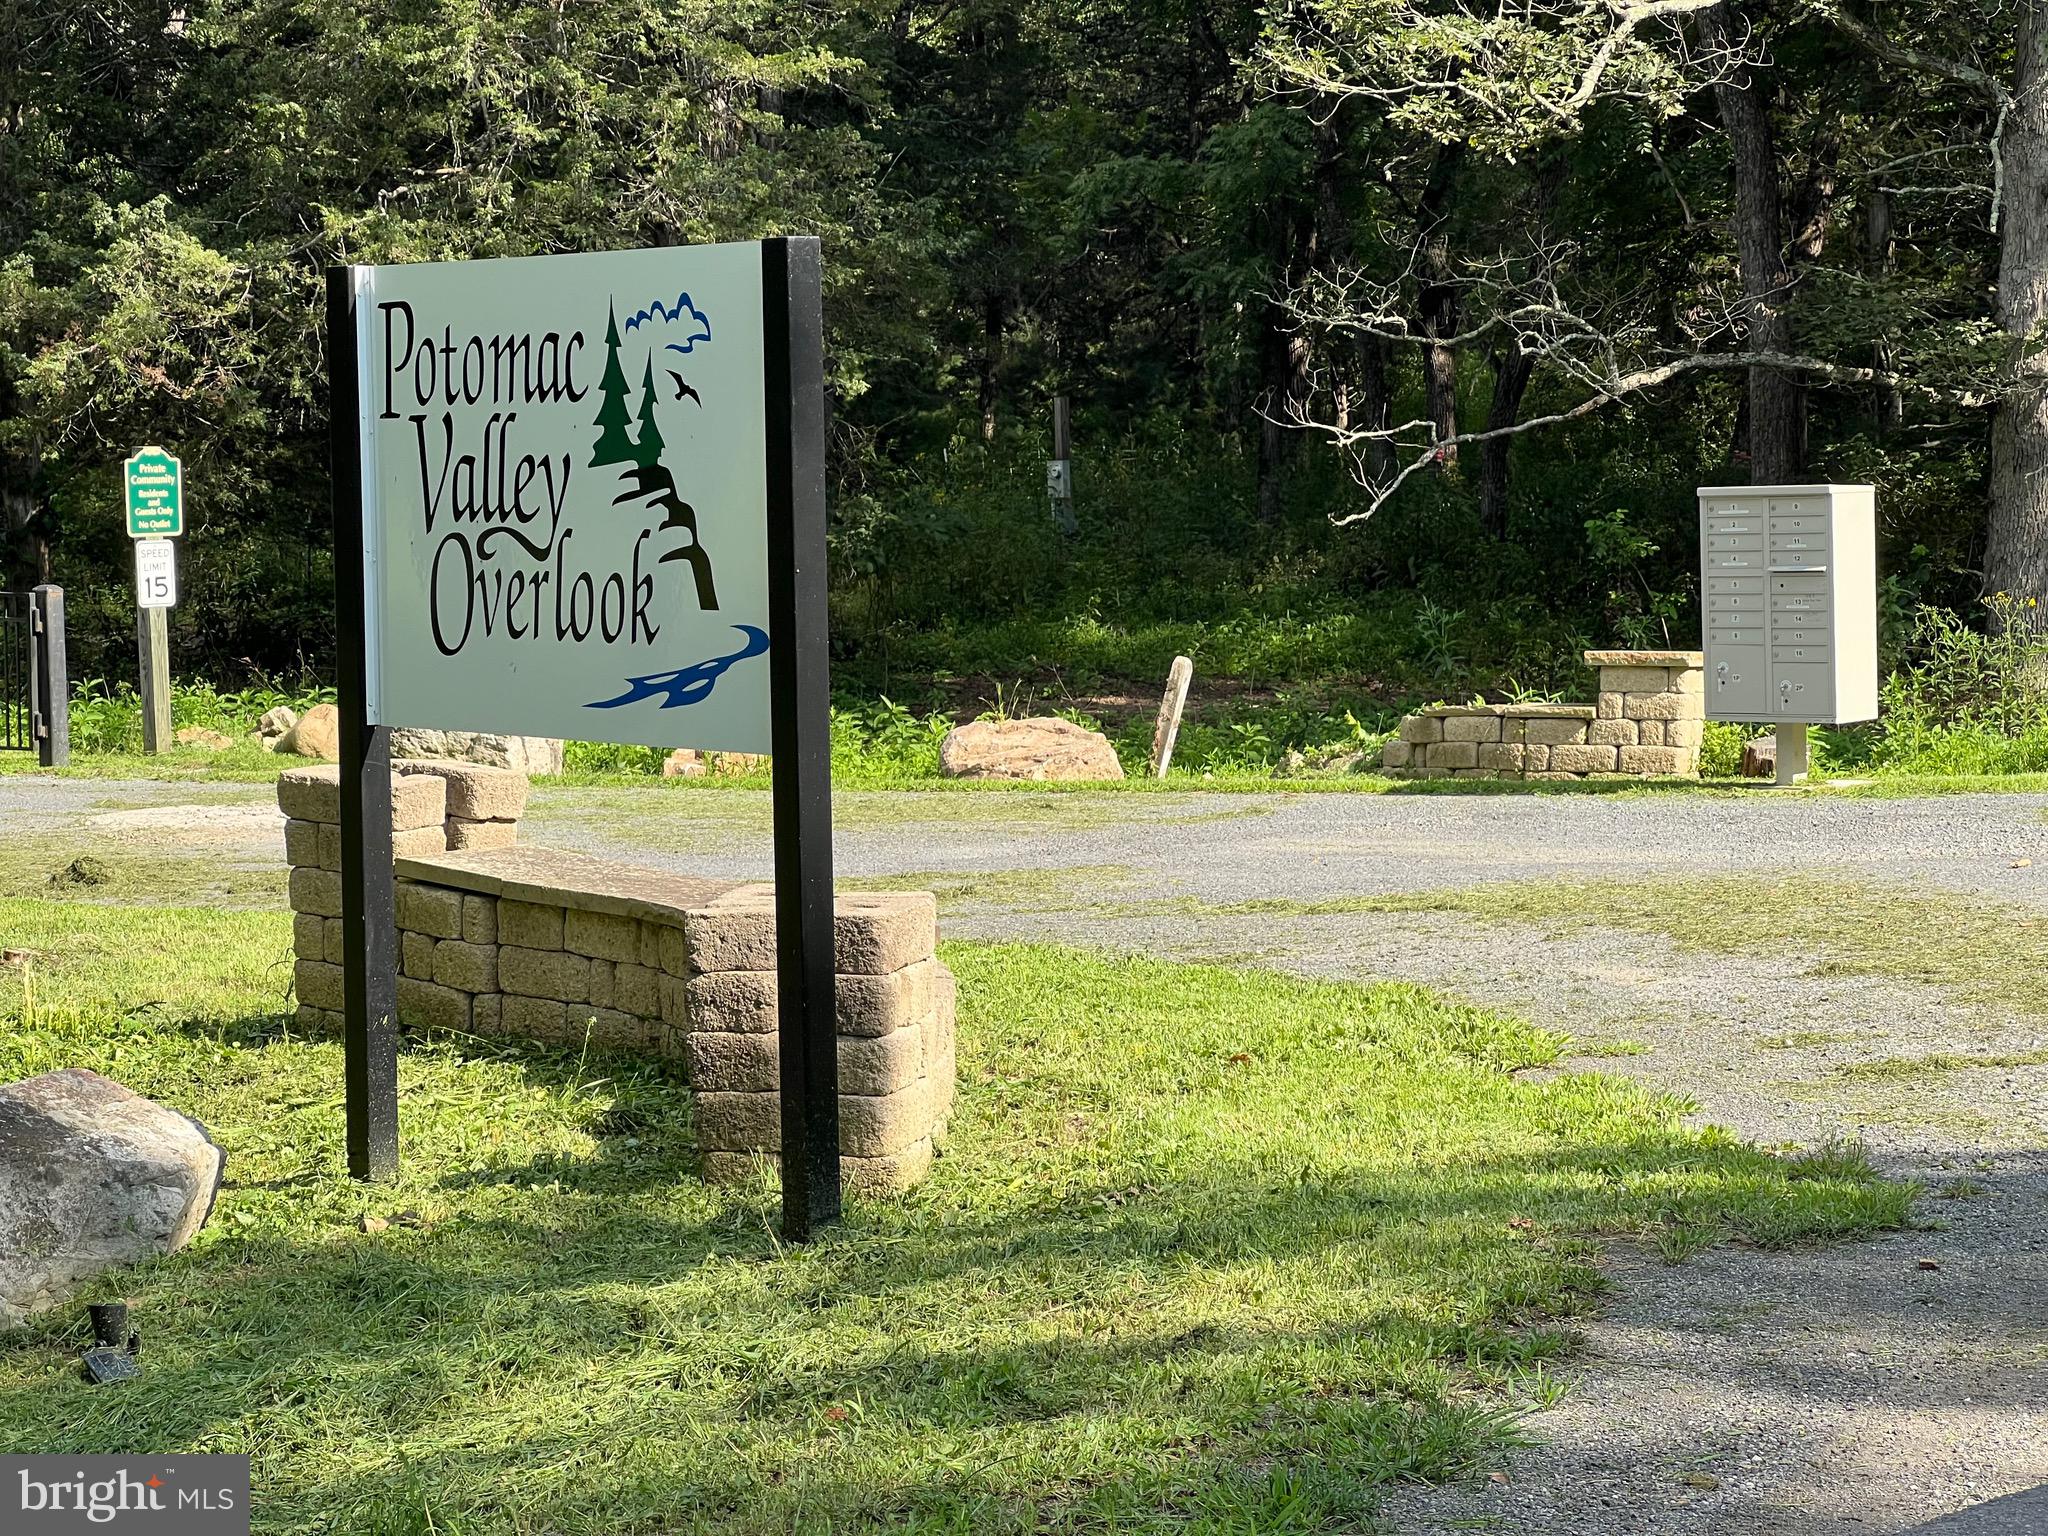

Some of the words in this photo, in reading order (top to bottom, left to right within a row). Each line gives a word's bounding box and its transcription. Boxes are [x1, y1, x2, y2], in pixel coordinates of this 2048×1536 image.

[377, 299, 589, 420] Potomac
[139, 463, 167, 474] Private
[130, 474, 176, 486] Community
[408, 410, 572, 562] Valley
[138, 489, 169, 498] Residents
[147, 498, 161, 507] and
[134, 507, 157, 516] Guests
[157, 506, 174, 517] Only
[138, 520, 150, 529] No
[149, 519, 171, 529] Outlet
[140, 548, 170, 558] SPEED
[143, 562, 167, 572] LIMIT
[144, 576, 169, 599] 15
[429, 527, 661, 657] Overlook
